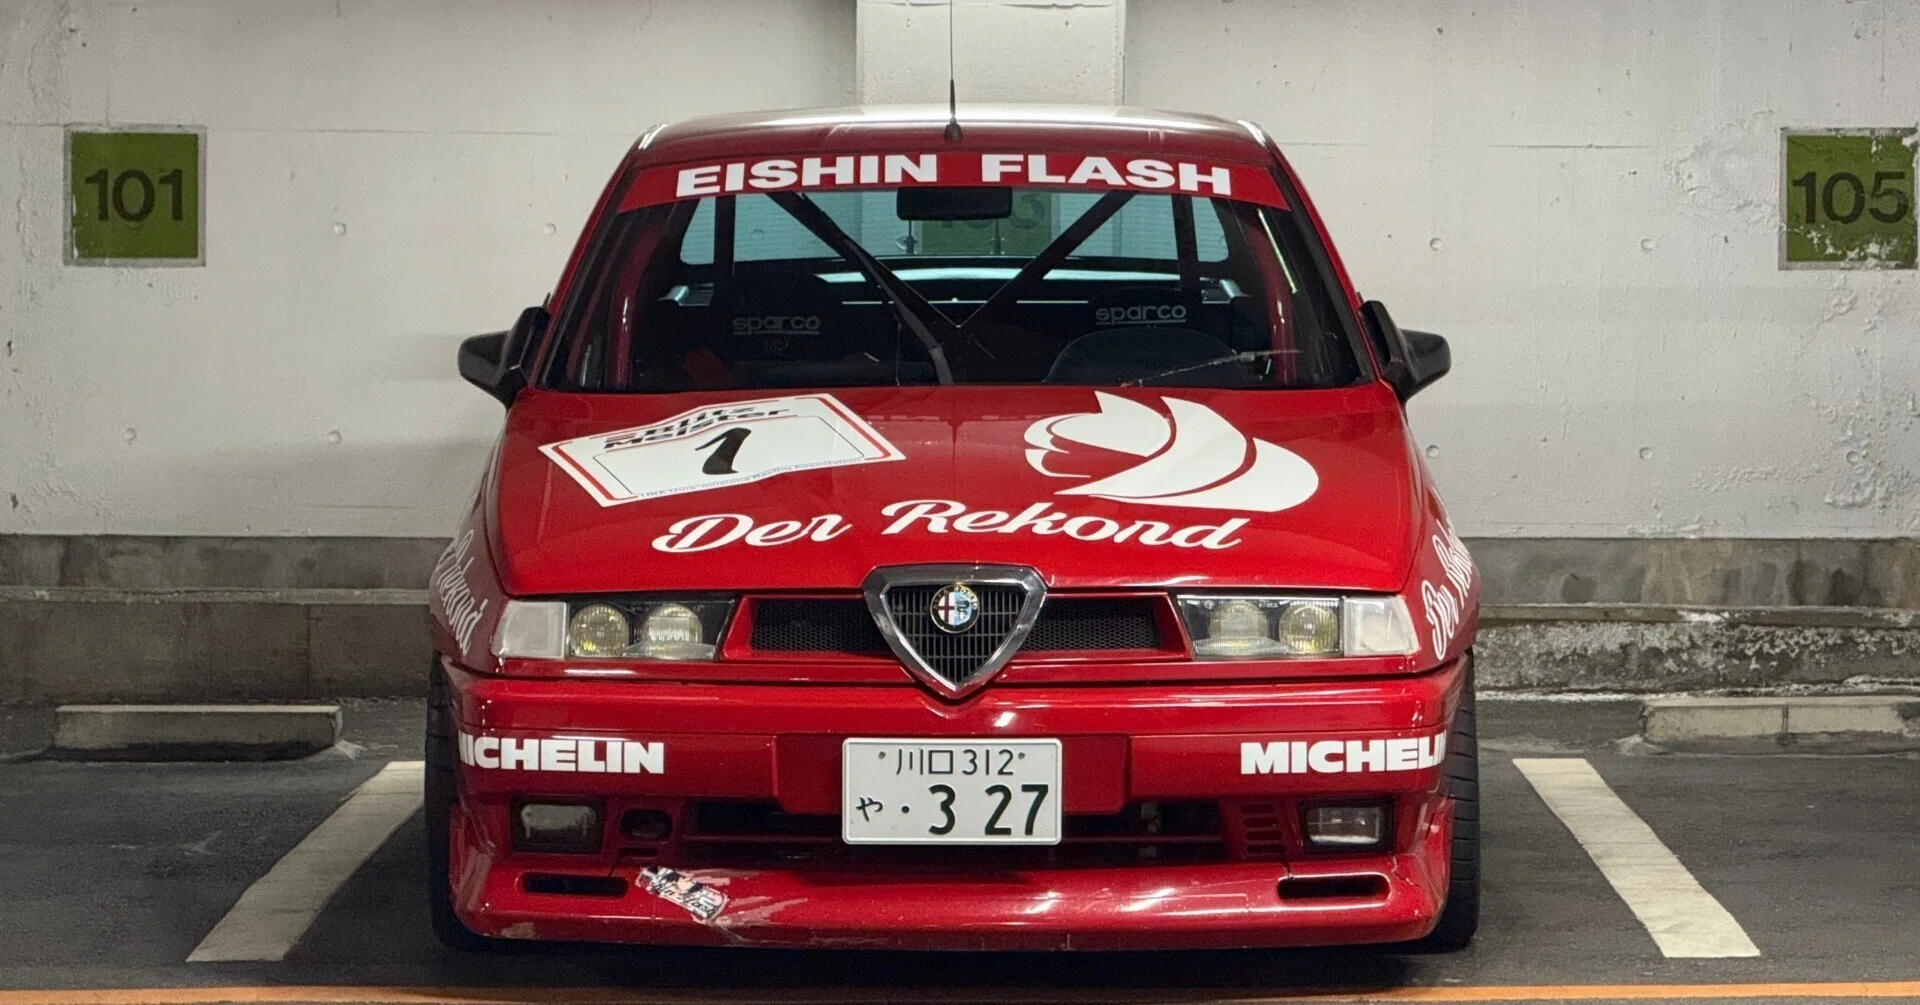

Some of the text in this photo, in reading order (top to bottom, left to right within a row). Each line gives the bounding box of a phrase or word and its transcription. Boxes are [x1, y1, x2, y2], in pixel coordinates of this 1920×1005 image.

[84, 168, 183, 222] 101
[676, 153, 1232, 198] EISHIN FLASH
[1792, 171, 1909, 225] 105
[732, 315, 821, 336] sparco
[1095, 304, 1188, 326] sparco
[693, 427, 752, 475] 1
[651, 499, 1250, 553] Der Rekond
